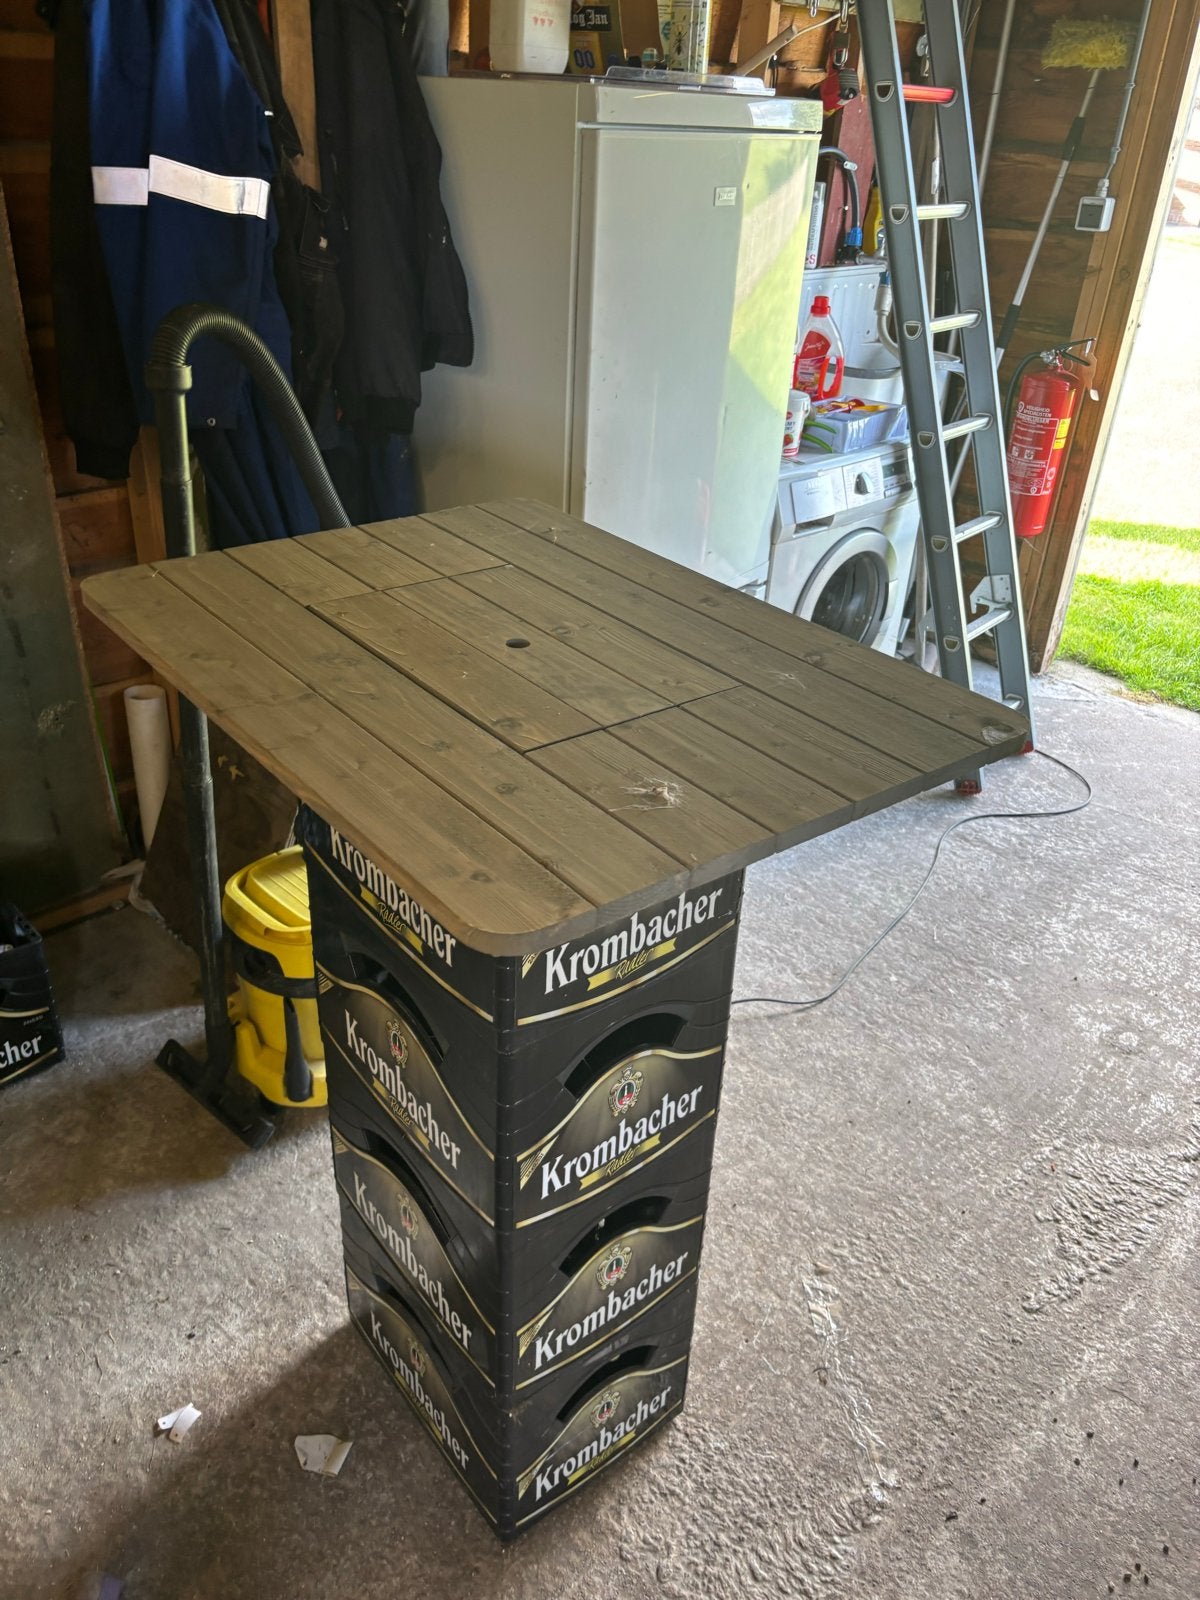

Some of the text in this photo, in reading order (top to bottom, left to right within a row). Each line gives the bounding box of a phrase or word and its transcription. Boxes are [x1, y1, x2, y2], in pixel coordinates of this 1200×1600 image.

[586, 9, 608, 25] Jan
[330, 825, 456, 967] Krombacher
[377, 902, 407, 932] Radler
[544, 886, 723, 994] Krombacher
[614, 948, 651, 979] Radler
[345, 1010, 461, 1170] Krombacher
[540, 1085, 703, 1199] Krombacher
[353, 1171, 472, 1350] Krombacher
[534, 1251, 688, 1370] Krombacher
[371, 1312, 469, 1470] Krombacher
[535, 1385, 671, 1502] Krombacher
